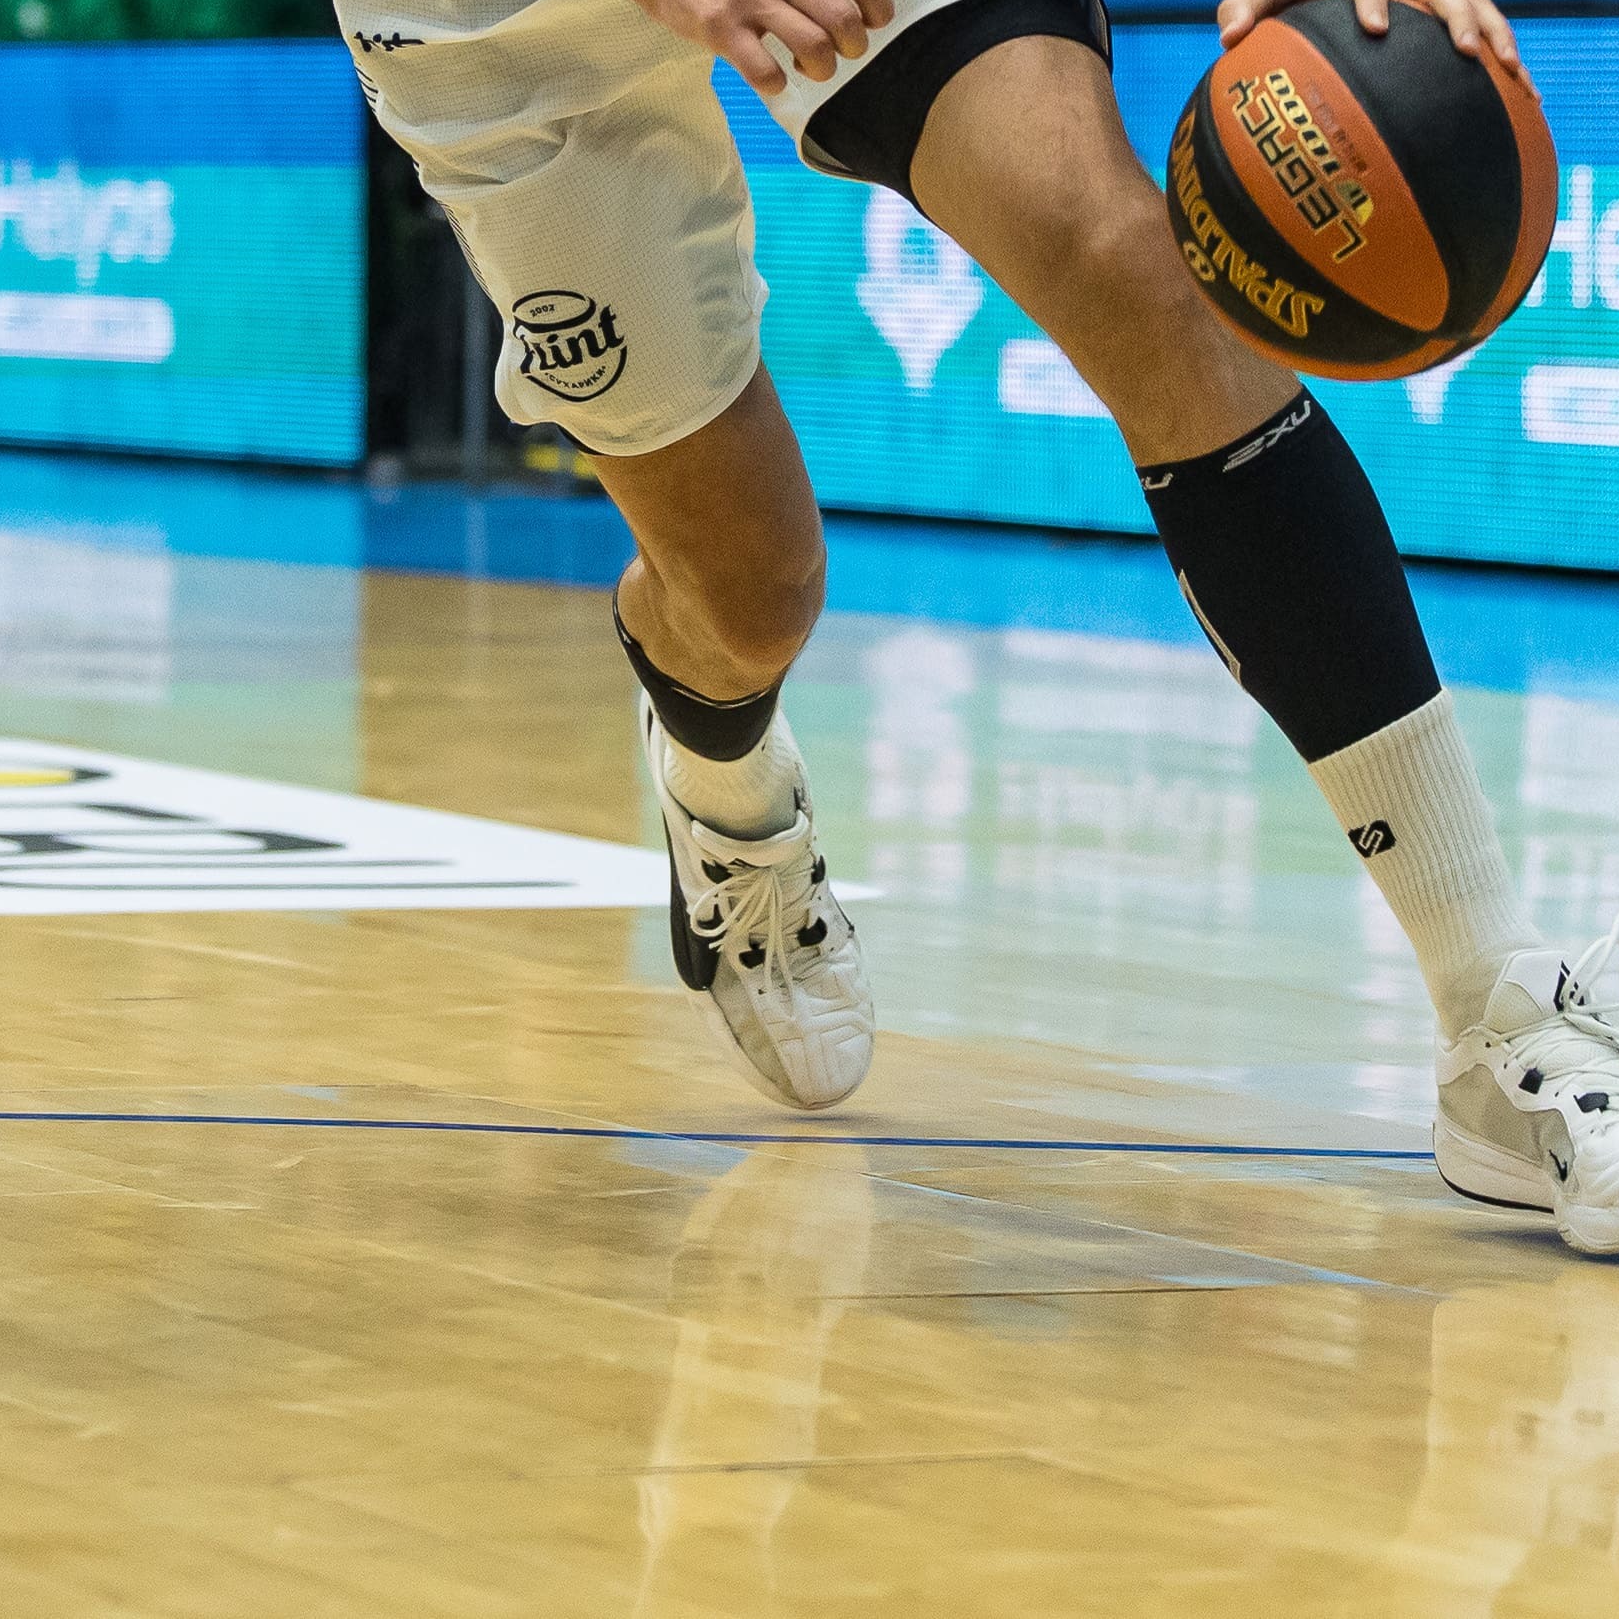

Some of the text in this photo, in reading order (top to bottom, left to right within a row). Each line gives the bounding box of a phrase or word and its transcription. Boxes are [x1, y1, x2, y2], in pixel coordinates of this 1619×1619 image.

[1171, 107, 1325, 337] SPALDING
[1229, 75, 1367, 264] LEGACY
[1222, 400, 1311, 473] 2XU
